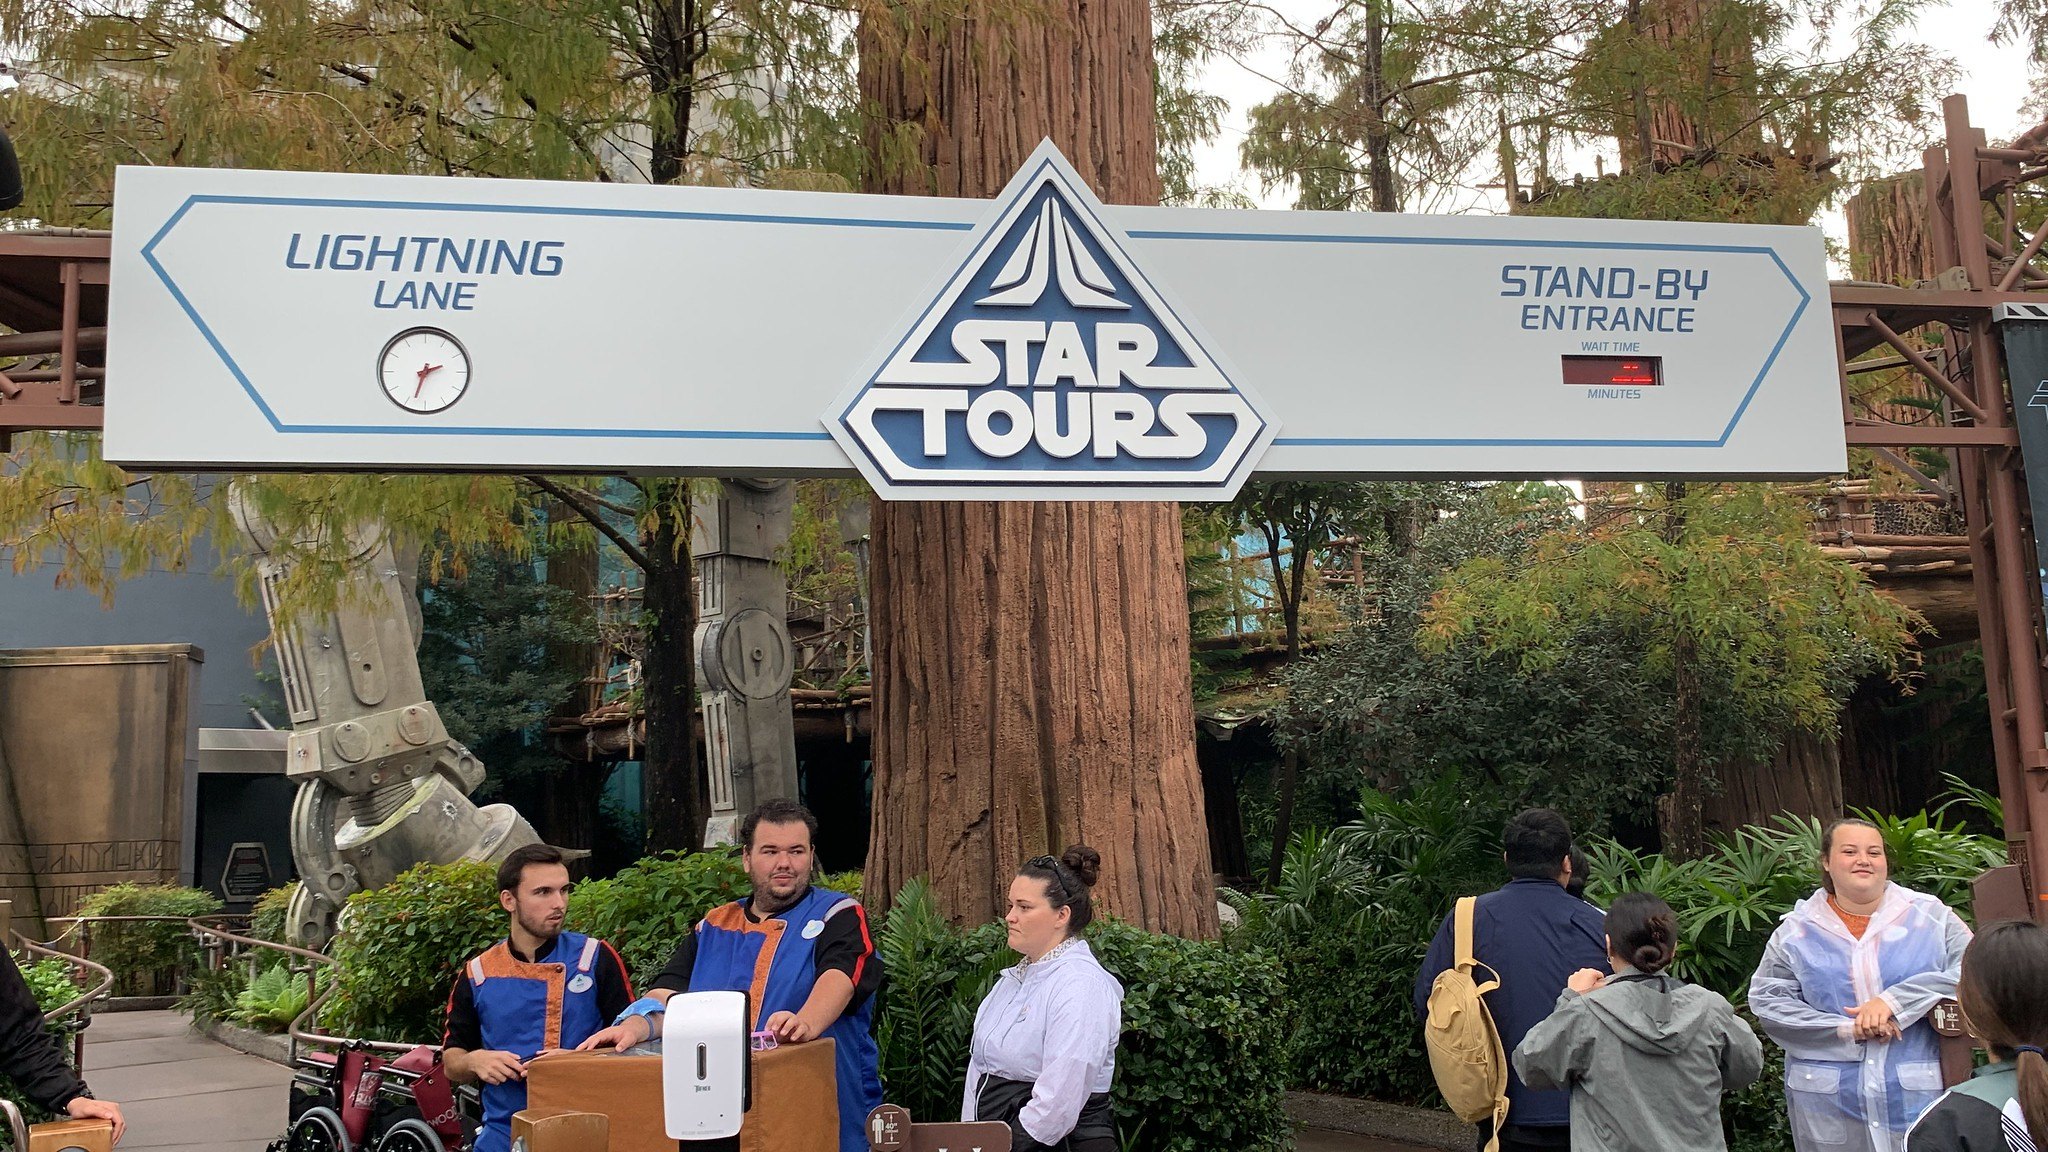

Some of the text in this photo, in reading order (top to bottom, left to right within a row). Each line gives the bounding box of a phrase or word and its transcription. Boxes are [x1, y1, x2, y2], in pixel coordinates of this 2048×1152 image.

[286, 232, 565, 276] LIGHTNING
[374, 280, 478, 311] LANE
[1500, 265, 1708, 300] STAND-BY
[1521, 304, 1695, 333] ENTRANCE
[876, 319, 1231, 390] STAR
[1581, 341, 1640, 352] WAIT TIME
[1587, 389, 1641, 399] MINUTES
[868, 388, 1240, 459] TOURS
